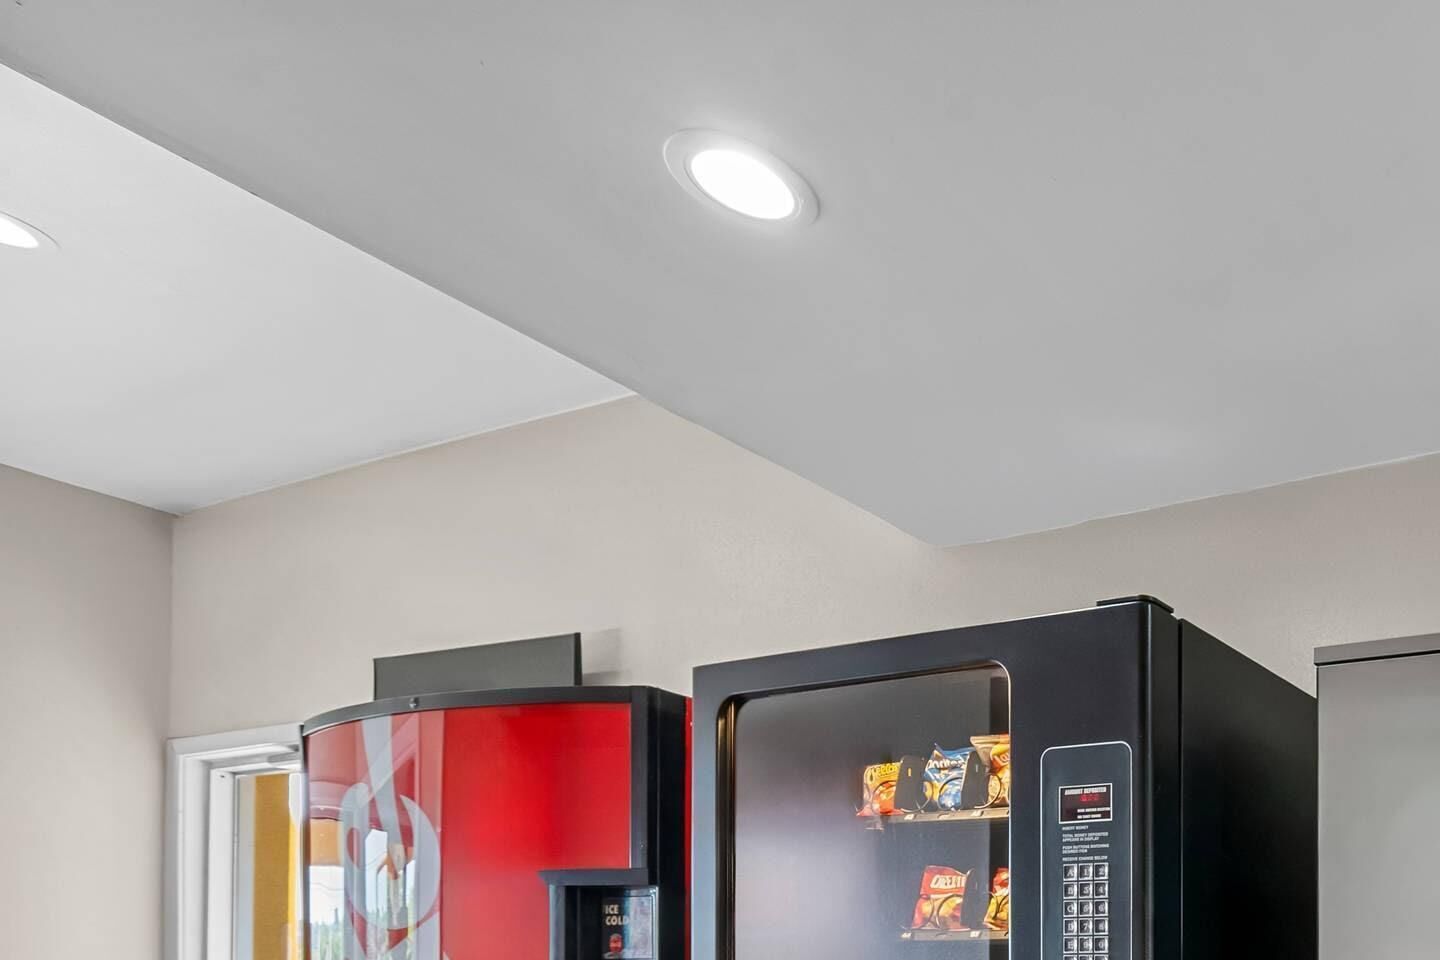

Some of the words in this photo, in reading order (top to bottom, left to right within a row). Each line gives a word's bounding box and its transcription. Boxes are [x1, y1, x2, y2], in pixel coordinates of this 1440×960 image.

[864, 762, 898, 785] Cheeto
[604, 904, 619, 914] ICE
[605, 915, 628, 926] COLD
